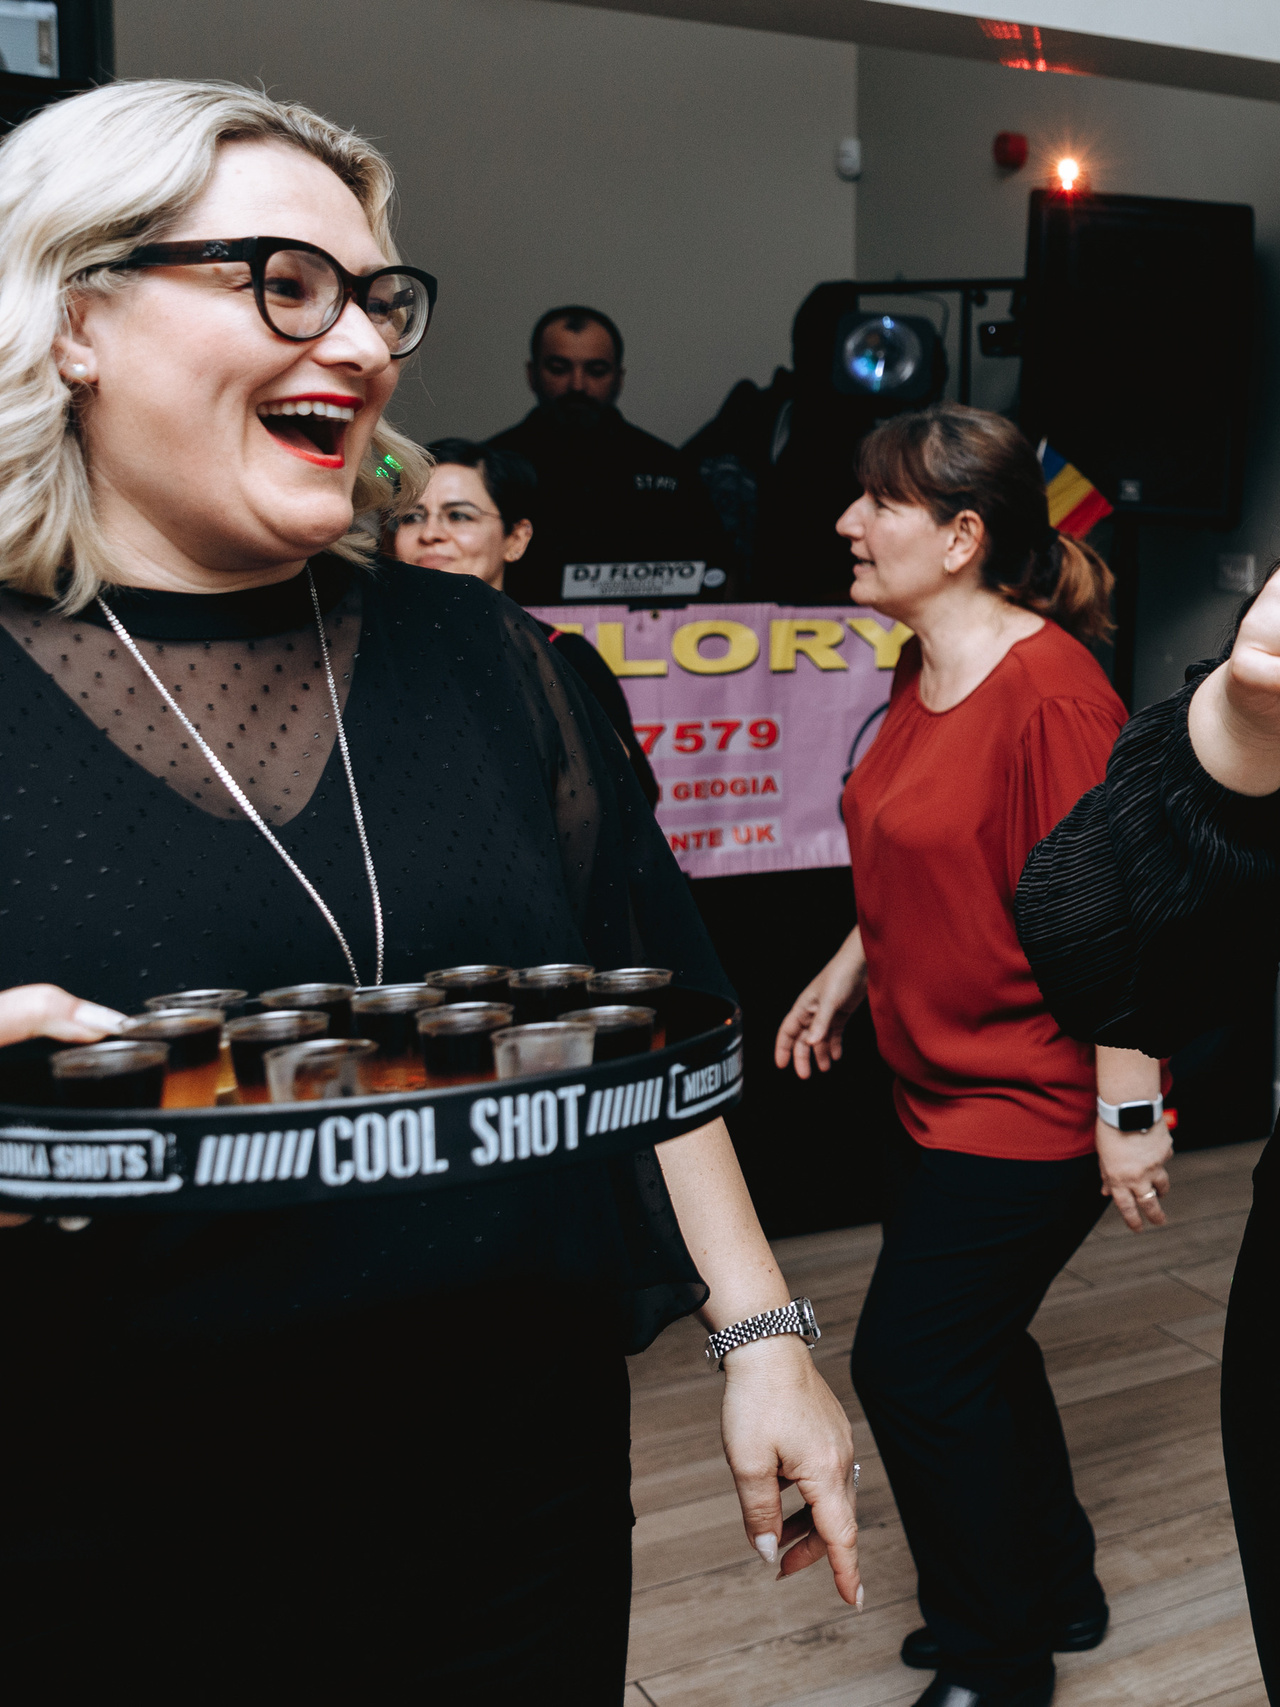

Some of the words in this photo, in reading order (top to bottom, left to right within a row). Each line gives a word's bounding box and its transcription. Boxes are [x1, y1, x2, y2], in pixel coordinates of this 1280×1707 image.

[573, 565, 600, 582] DJ
[632, 718, 780, 755] 7579
[673, 776, 777, 801] GEOGIA
[732, 824, 775, 845] UK
[683, 1063, 722, 1103] MIXED
[318, 1106, 449, 1187] COOL
[470, 1084, 586, 1167] SHOT
[52, 1144, 148, 1180] SHOTS
